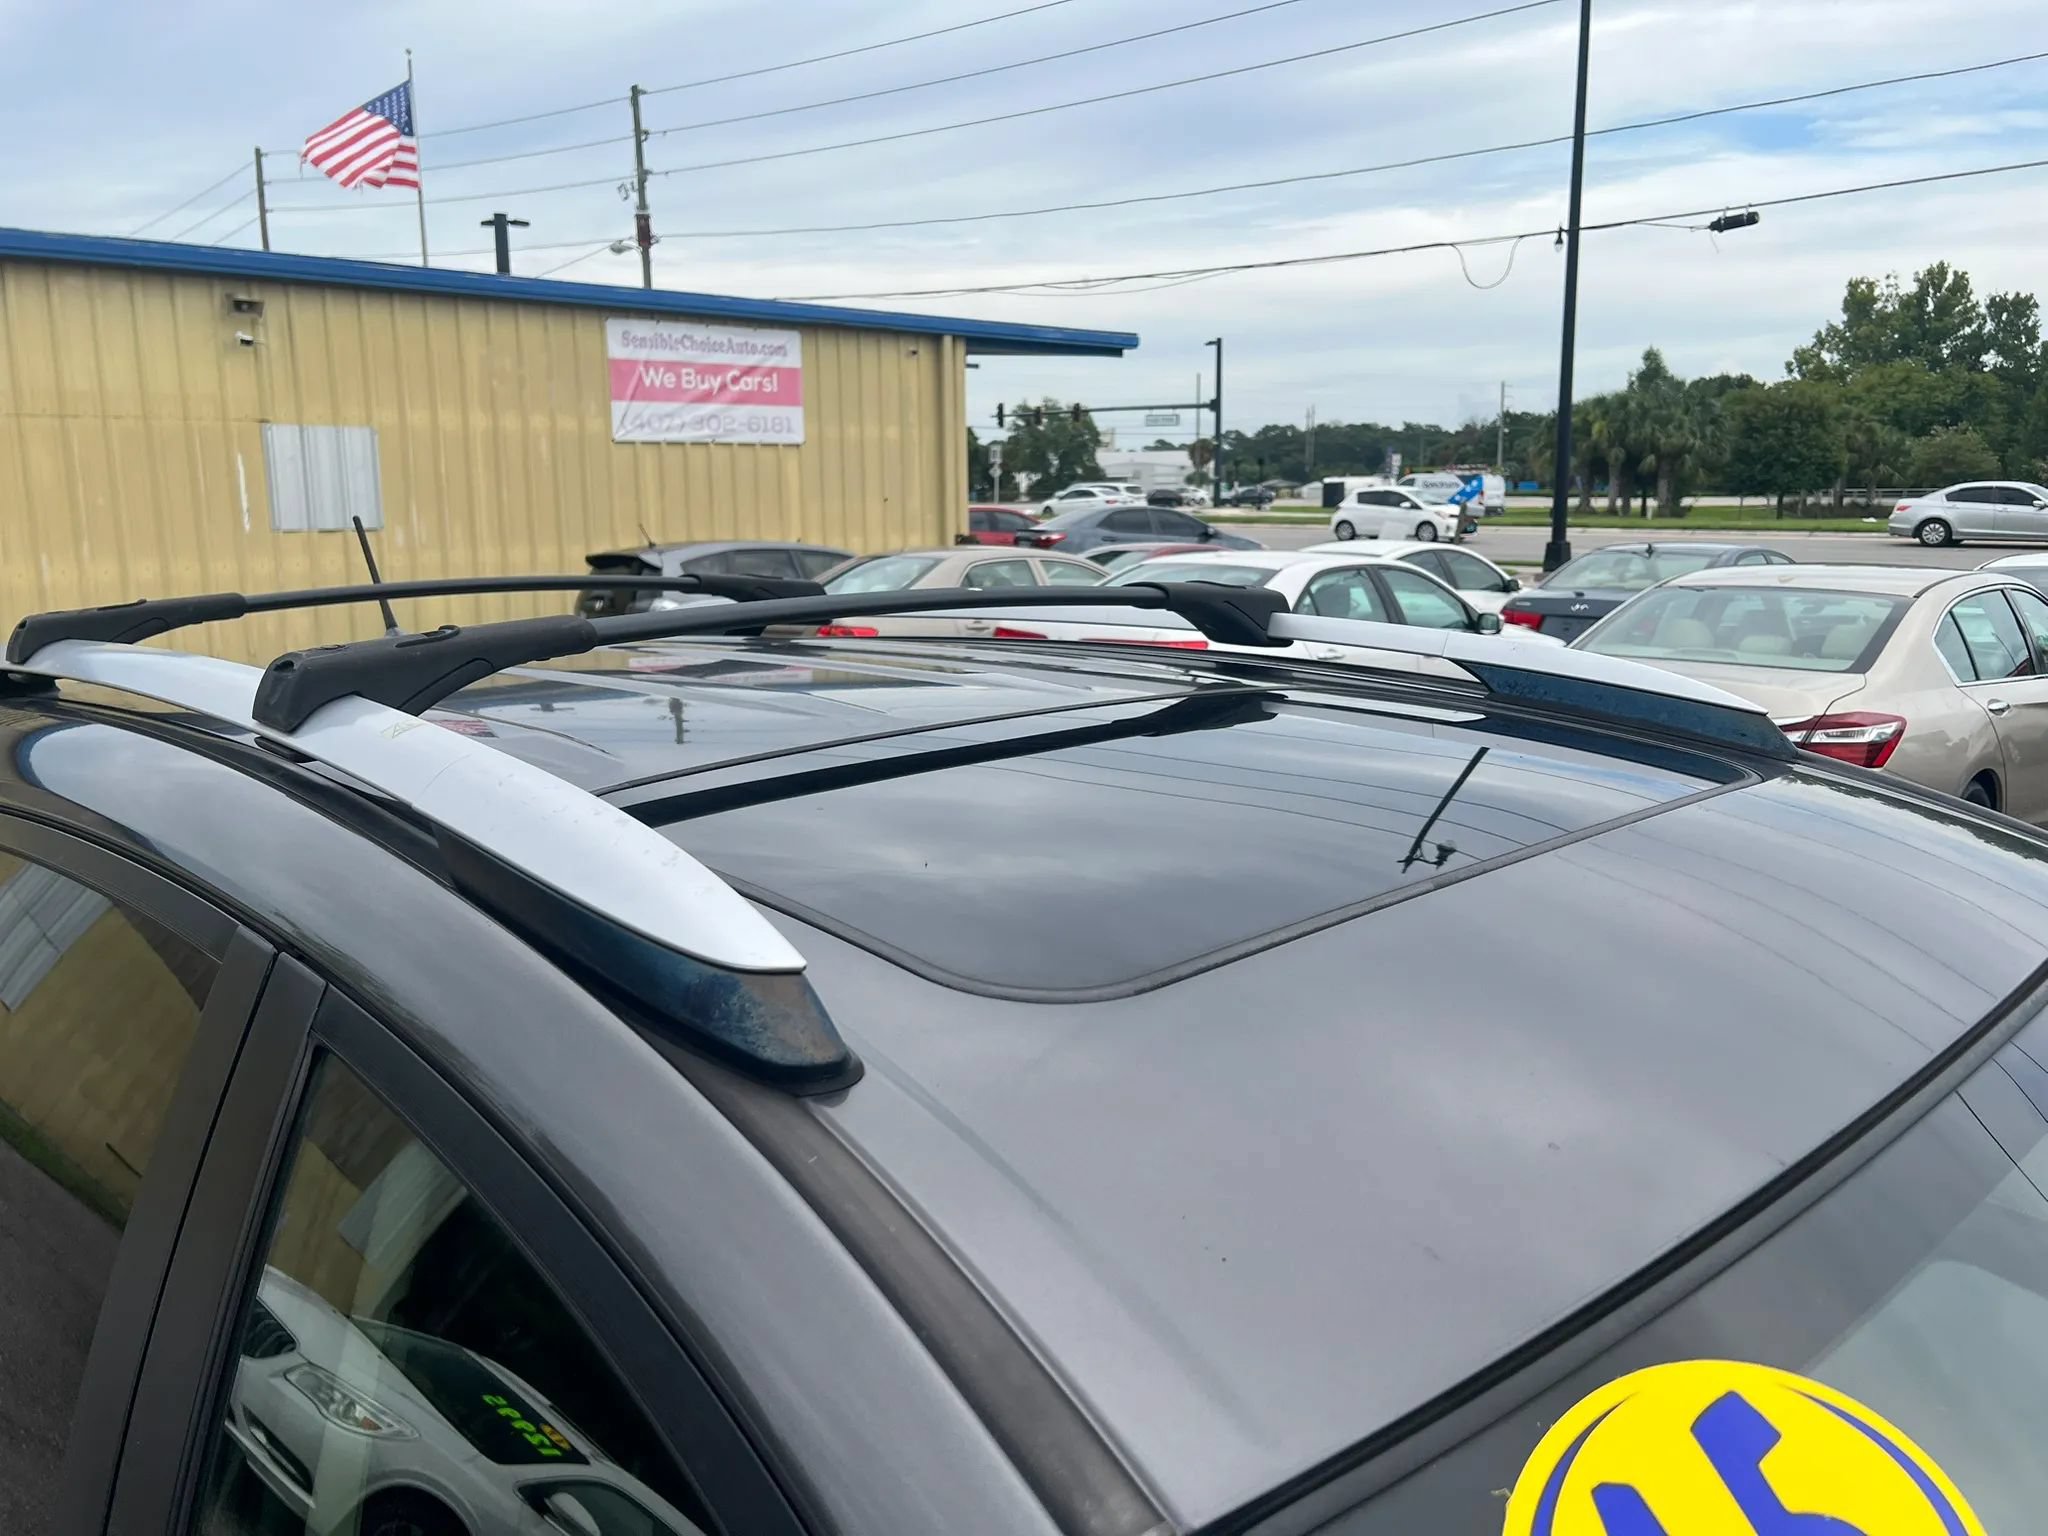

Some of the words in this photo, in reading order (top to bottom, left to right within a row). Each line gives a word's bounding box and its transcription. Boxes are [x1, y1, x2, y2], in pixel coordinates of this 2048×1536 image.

[621, 330, 789, 357] SensibleChoiceAuto.com
[640, 367, 676, 389] We
[682, 368, 722, 395] Buy
[727, 369, 778, 393] Cars!
